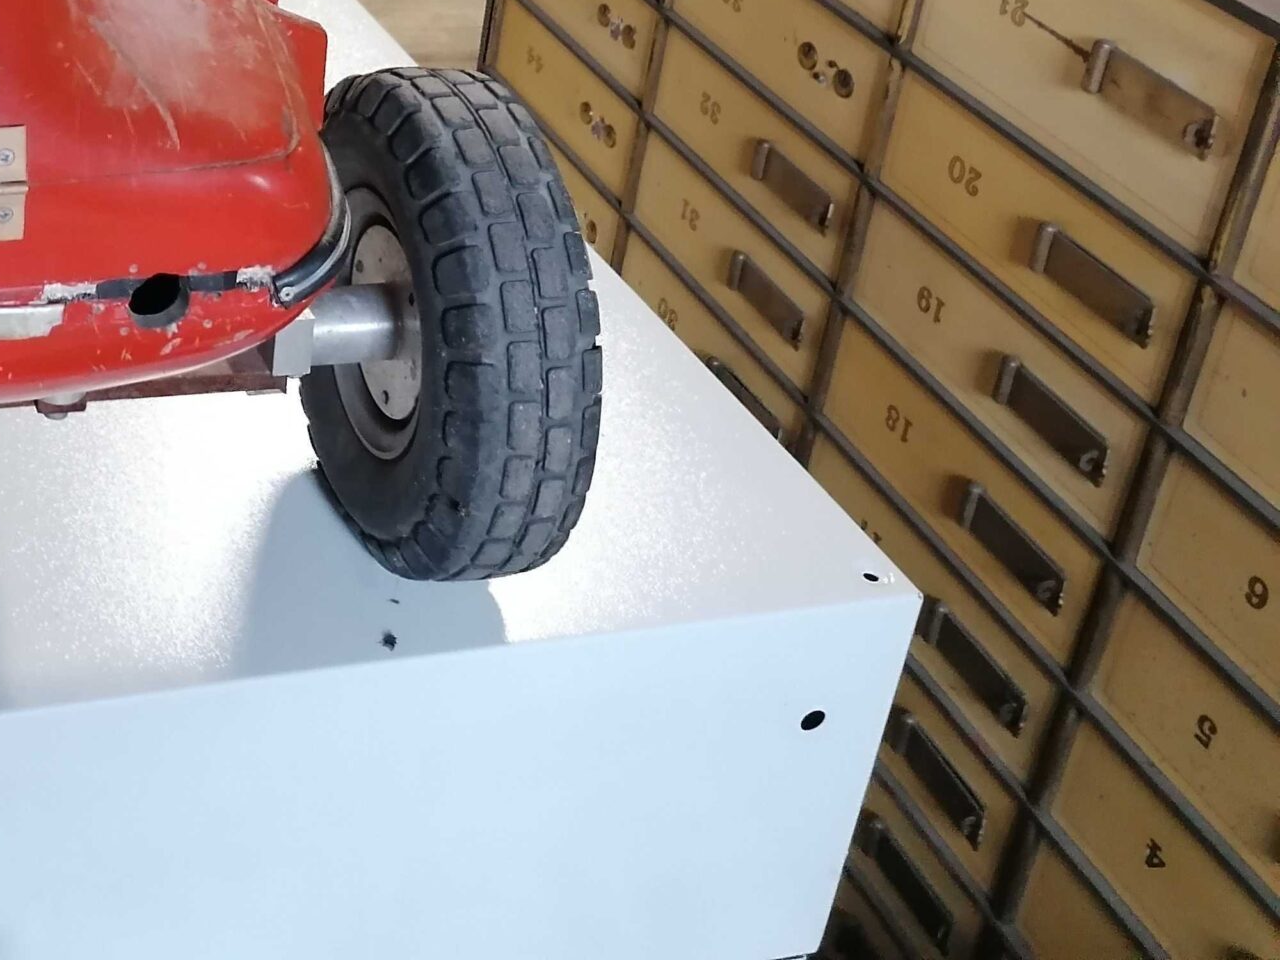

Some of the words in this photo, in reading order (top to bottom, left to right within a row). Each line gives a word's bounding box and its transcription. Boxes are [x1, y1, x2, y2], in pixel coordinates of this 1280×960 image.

[699, 91, 722, 125] 32
[948, 155, 981, 197] 20
[681, 198, 700, 232] 31
[916, 286, 945, 324] 19
[885, 404, 913, 443] 18
[1193, 714, 1218, 749] 5
[1145, 837, 1166, 868] 4
